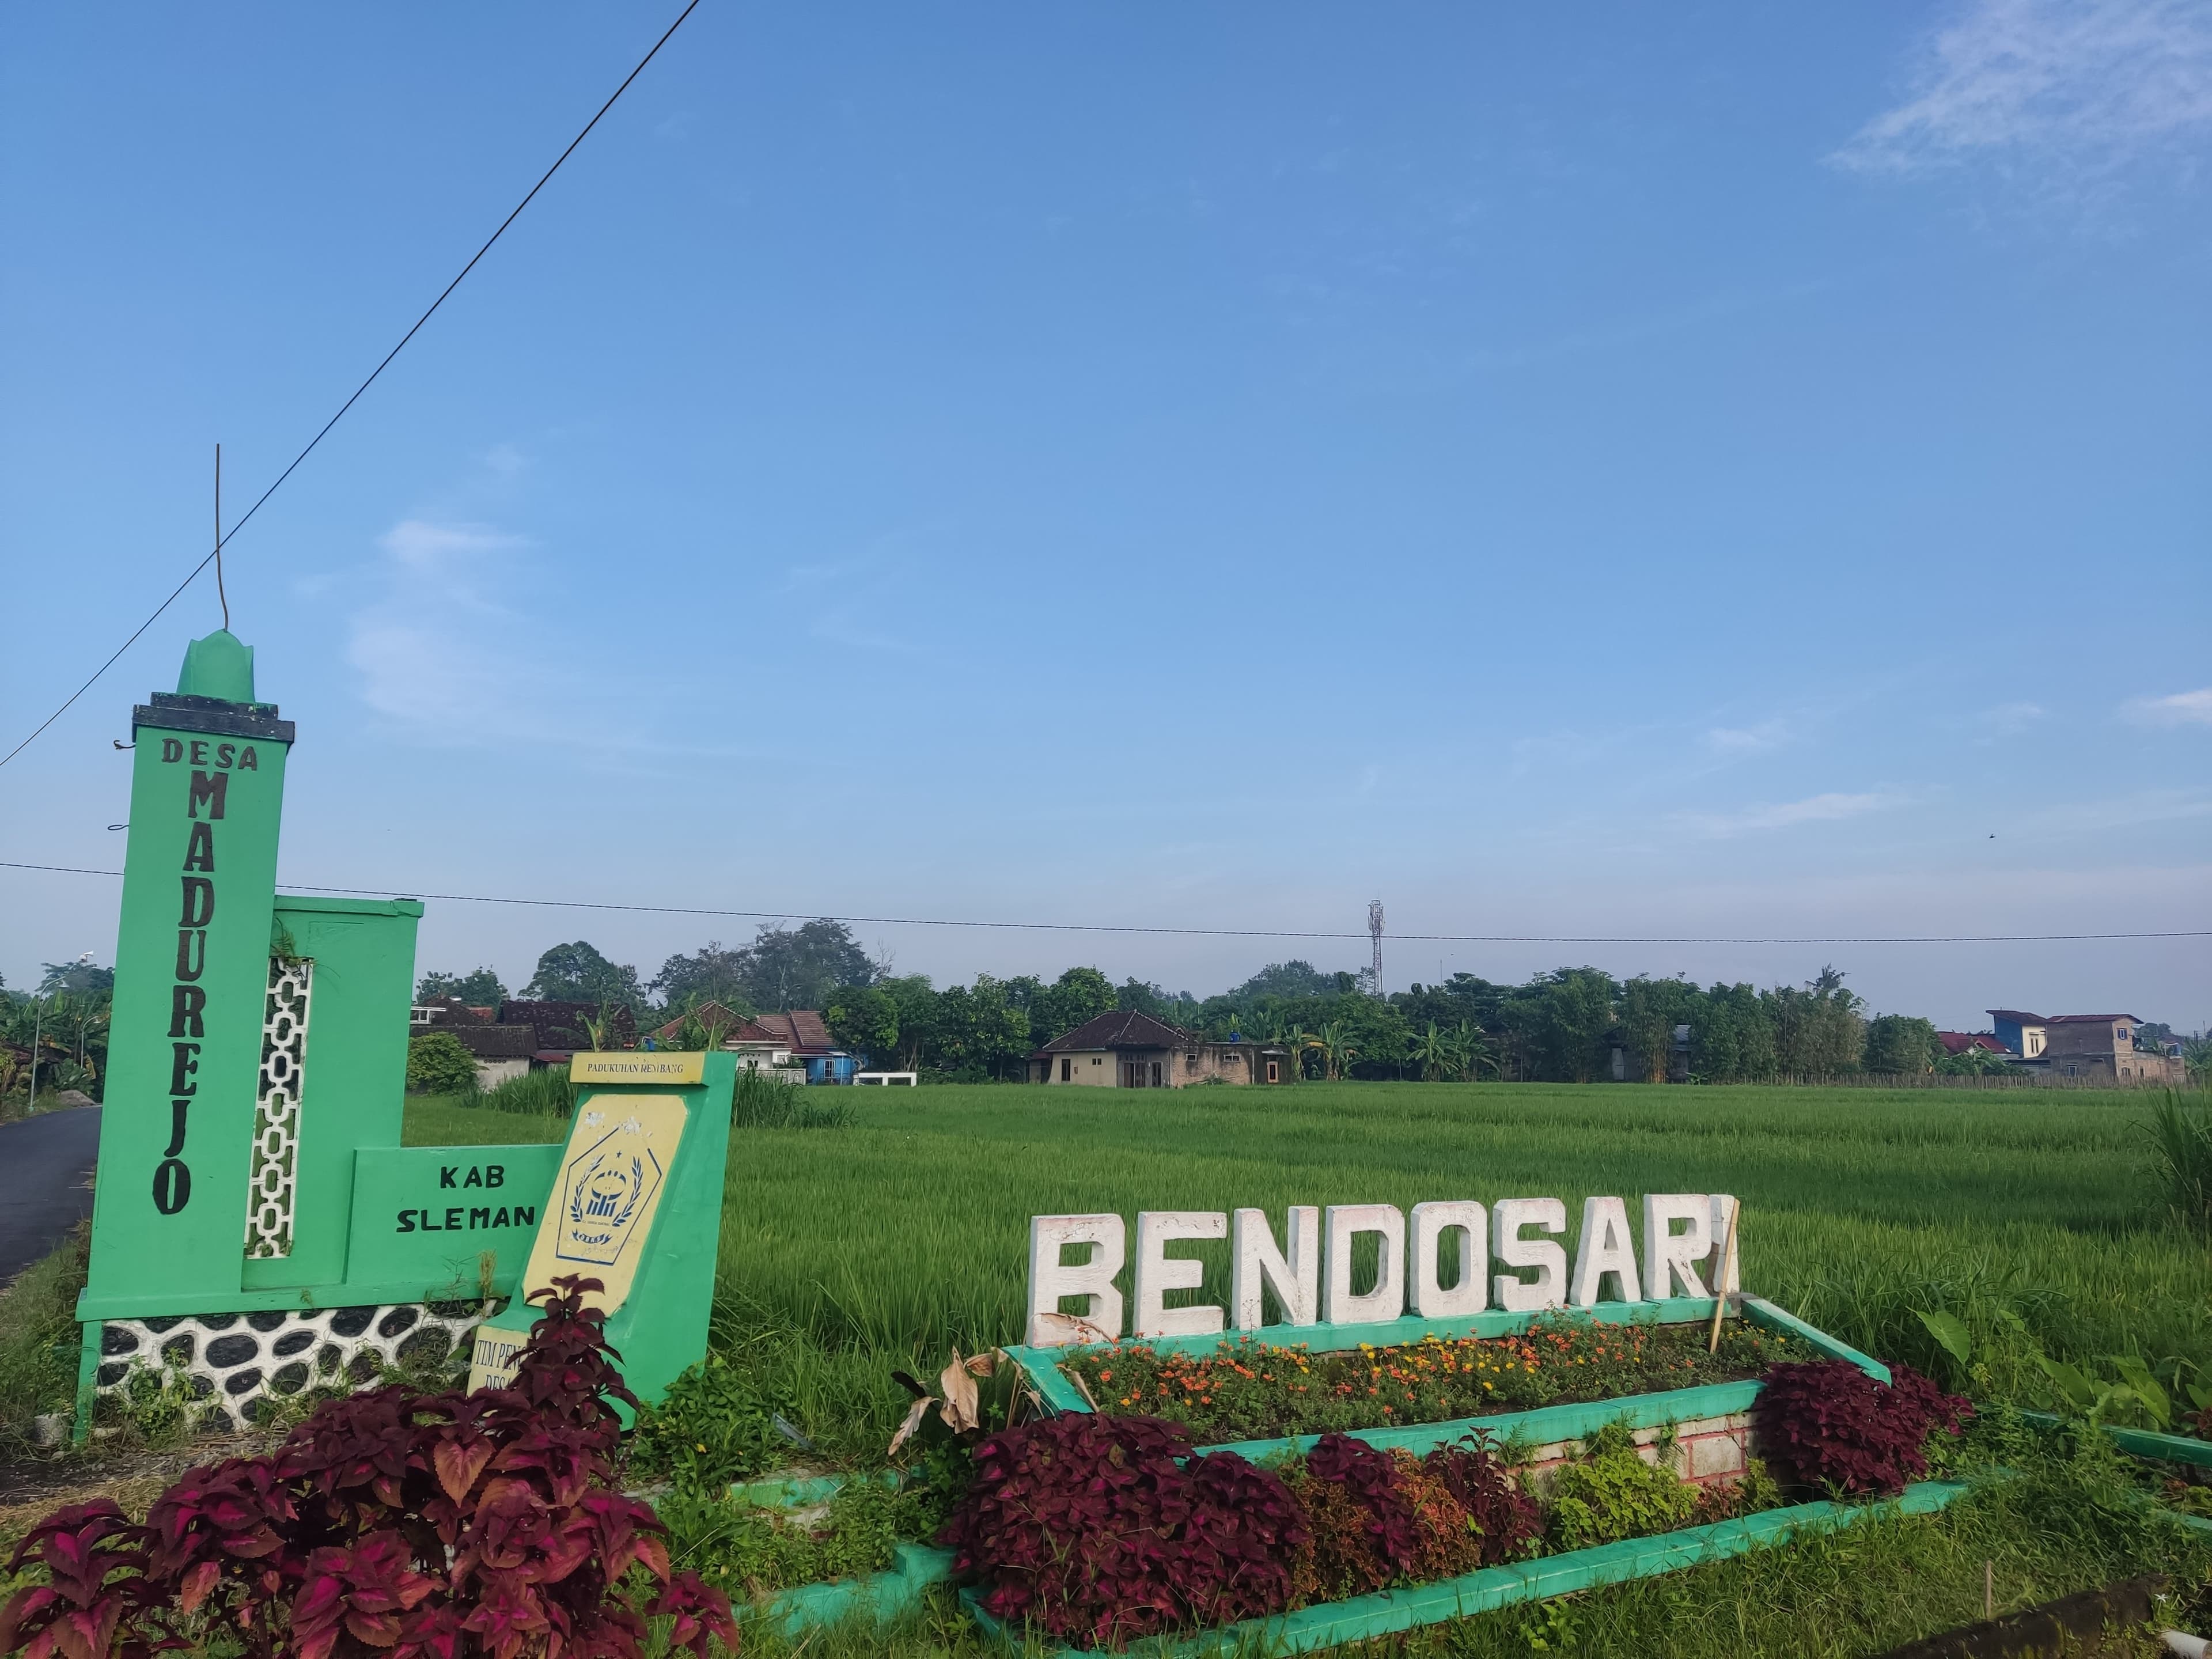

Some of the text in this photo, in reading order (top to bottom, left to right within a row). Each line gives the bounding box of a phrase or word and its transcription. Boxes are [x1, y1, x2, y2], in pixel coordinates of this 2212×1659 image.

[161, 738, 257, 771] DESA
[152, 770, 228, 1215] MADUREJO
[587, 1063, 639, 1073] PADUKUHAN
[440, 1165, 505, 1189] KAB
[396, 1206, 535, 1233] SLEMAN
[475, 1340, 498, 1367] TIM
